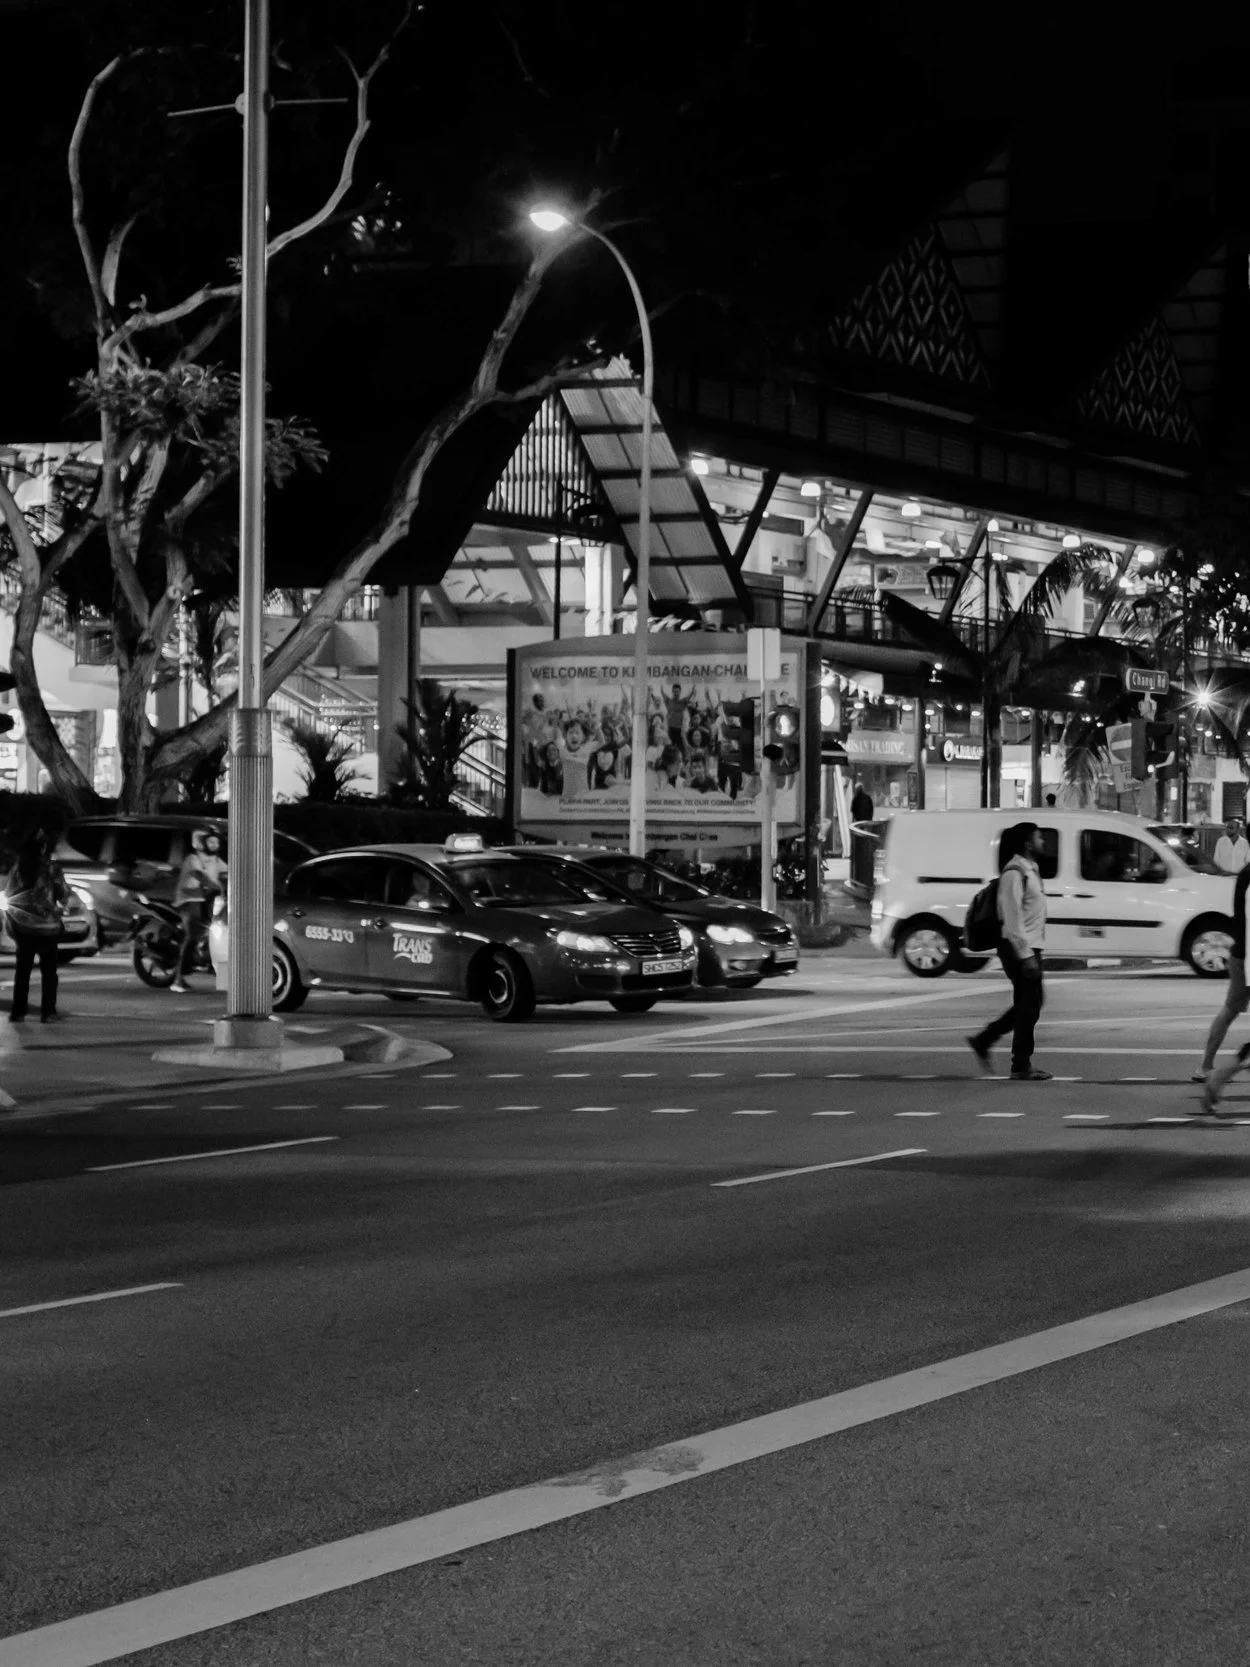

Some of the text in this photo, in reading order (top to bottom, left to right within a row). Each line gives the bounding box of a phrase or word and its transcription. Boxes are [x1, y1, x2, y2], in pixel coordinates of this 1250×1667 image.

[530, 663, 748, 679] WELCOME TO KBANGAN-CHAI
[1132, 672, 1166, 690] Changi Rd
[700, 832, 718, 840] Cee
